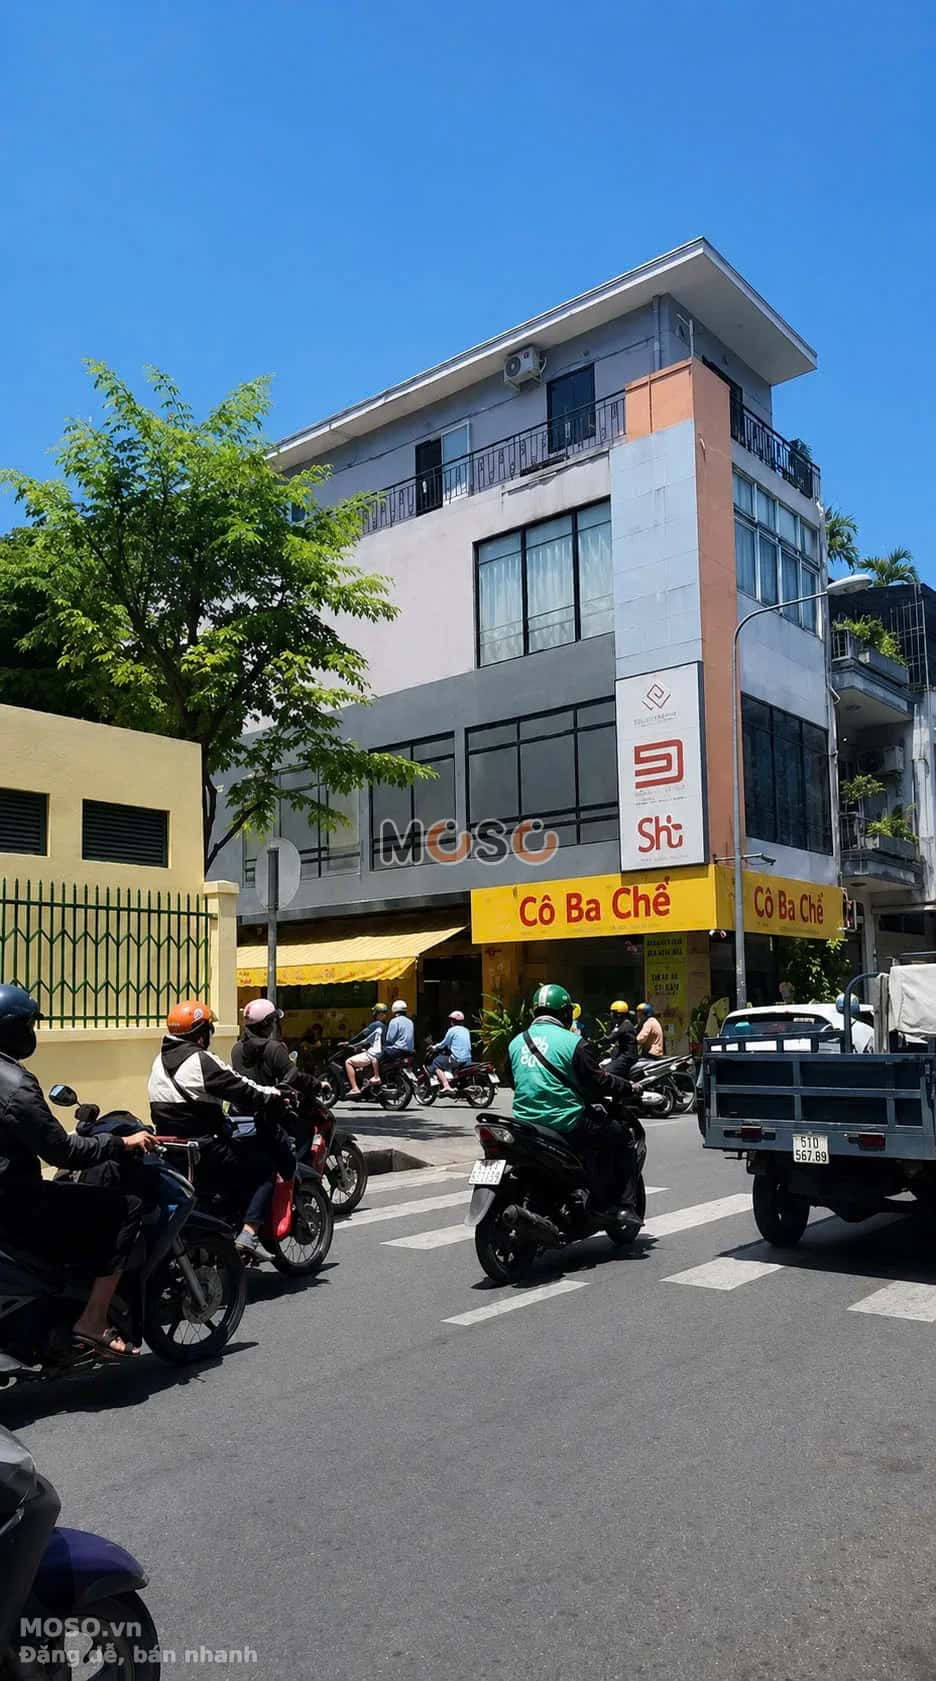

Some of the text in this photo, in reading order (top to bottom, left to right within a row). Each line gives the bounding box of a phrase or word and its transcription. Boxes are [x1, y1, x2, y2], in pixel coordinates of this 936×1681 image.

[519, 894, 555, 927] Cô
[566, 892, 601, 923] Ba
[754, 886, 773, 918] Cô
[778, 890, 795, 920] Ba
